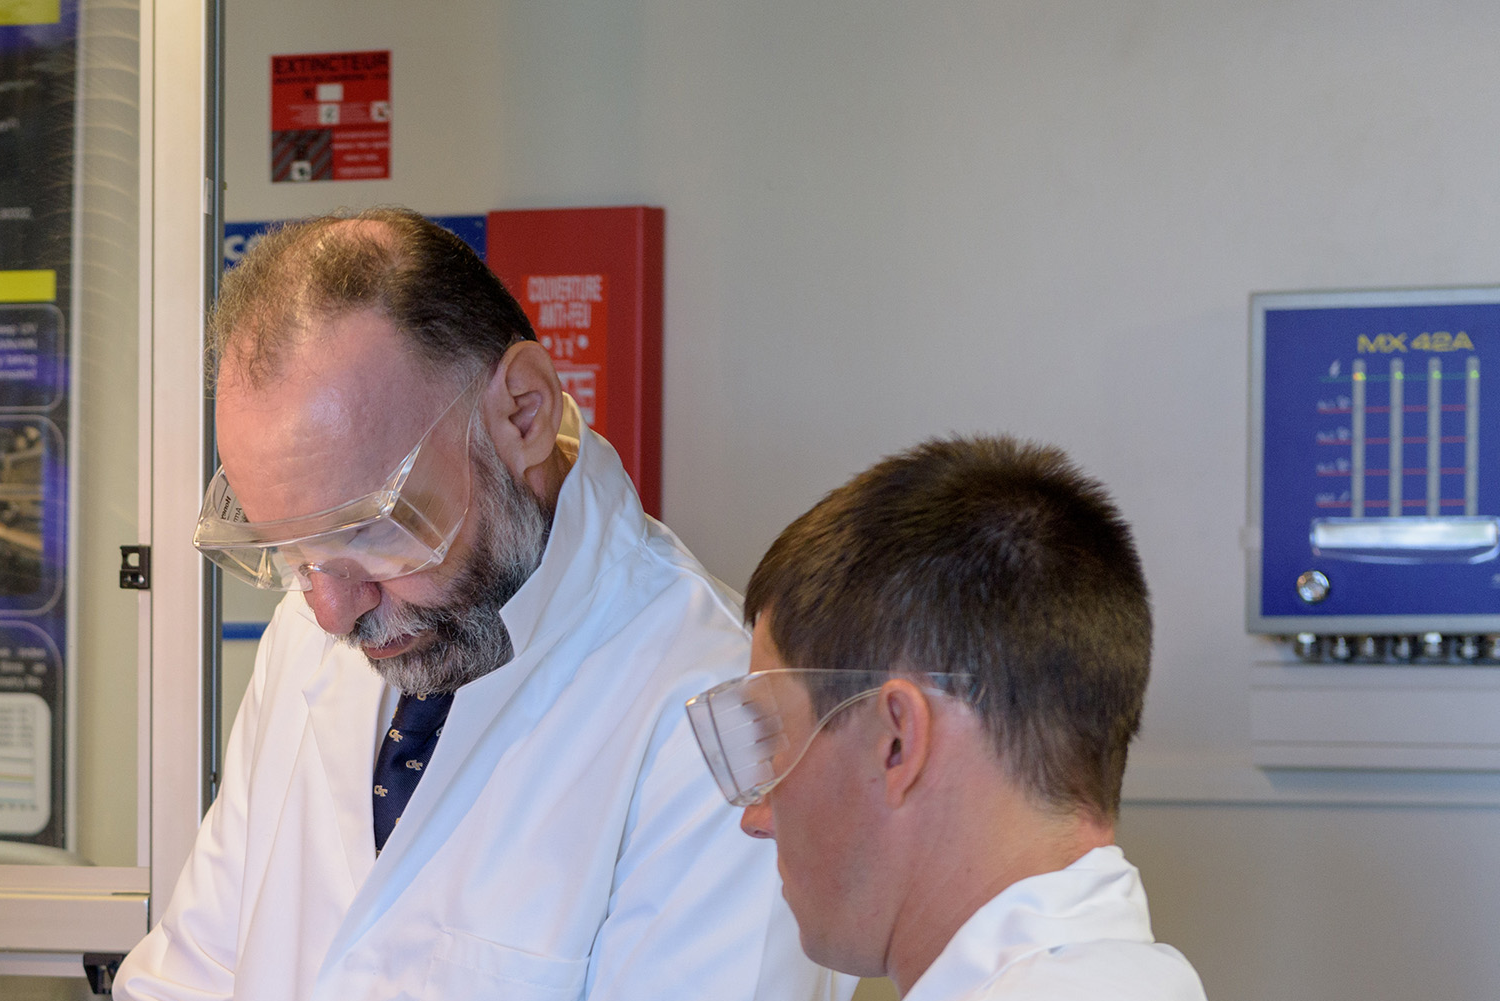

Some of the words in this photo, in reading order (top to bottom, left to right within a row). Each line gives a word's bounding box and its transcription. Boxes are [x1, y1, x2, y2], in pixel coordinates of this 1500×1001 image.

[527, 274, 602, 302] COUVERTURE
[1357, 333, 1408, 354] MX
[1411, 330, 1474, 353] 42A
